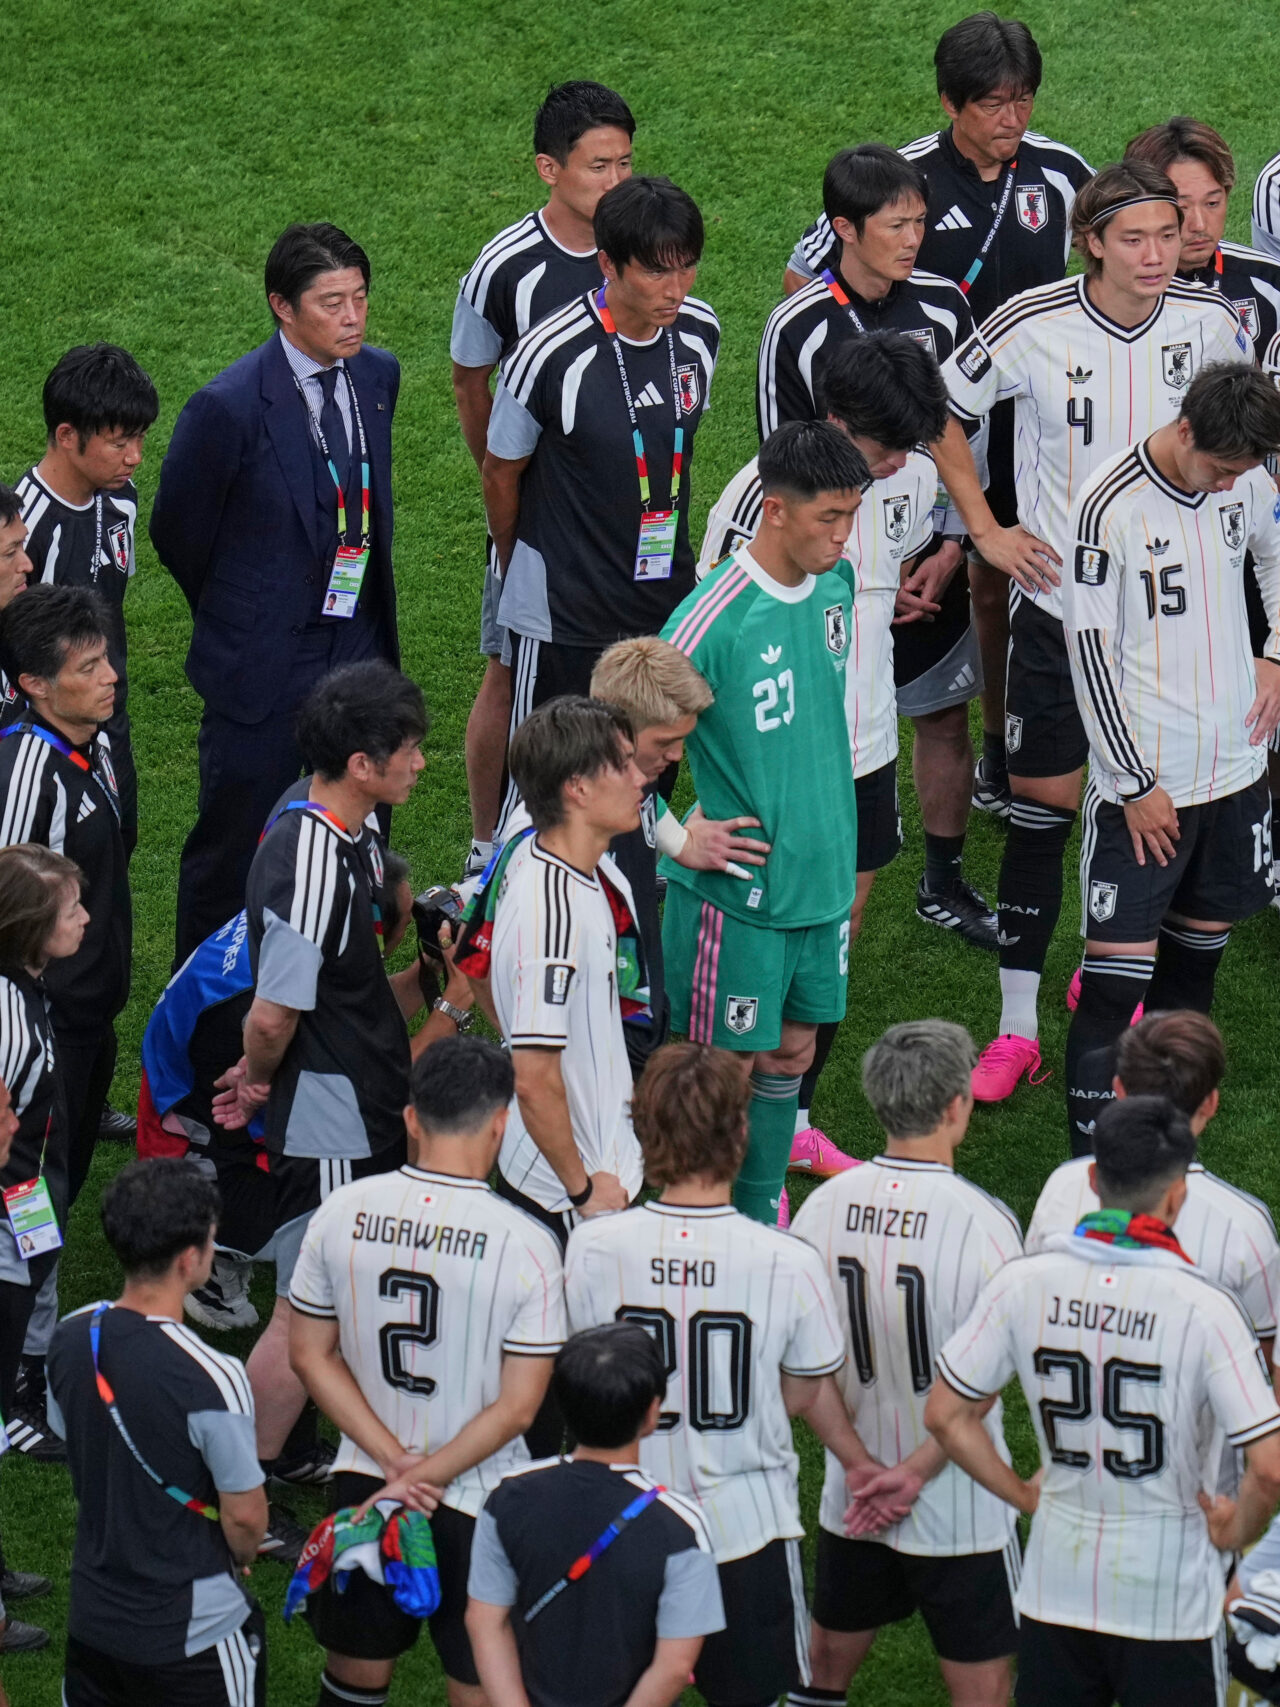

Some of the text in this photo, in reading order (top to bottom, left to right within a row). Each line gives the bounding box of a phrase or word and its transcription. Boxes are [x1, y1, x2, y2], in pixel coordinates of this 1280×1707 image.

[981, 173, 1013, 253] FIFA WORLD CUP 2026
[612, 339, 637, 424] FIFA WORLD CUP 2026
[668, 349, 677, 375] WORLD
[671, 375, 679, 393] CUP
[1171, 375, 1186, 384] JFA
[674, 393, 682, 421] 2026
[1067, 397, 1093, 446] 4
[95, 522, 103, 539] CUP
[1139, 563, 1187, 621] 15
[352, 1212, 488, 1261] SUGAWARA
[846, 1204, 928, 1241] DAIZEN
[651, 1258, 715, 1288] SEKO
[379, 1267, 441, 1398] 2
[837, 1256, 933, 1396] 11
[1048, 1297, 1157, 1342] J.SUZUKI
[1033, 1347, 1166, 1481] 25
